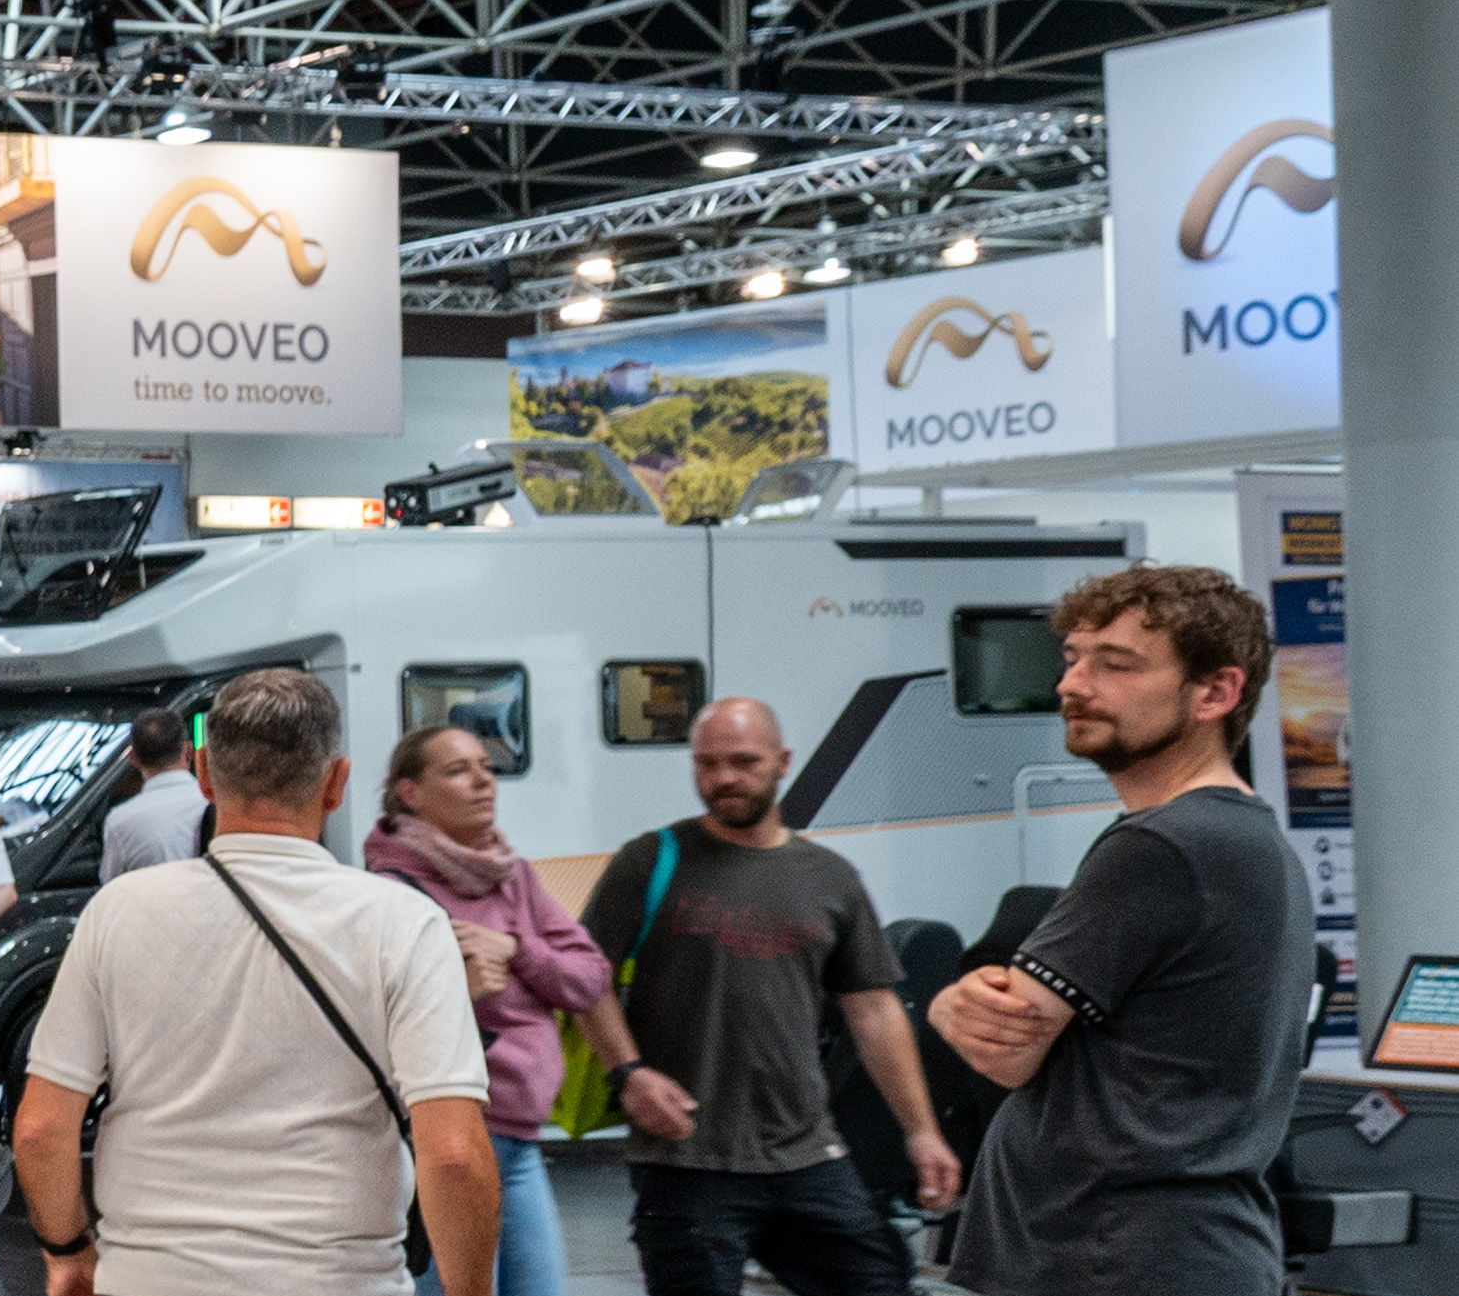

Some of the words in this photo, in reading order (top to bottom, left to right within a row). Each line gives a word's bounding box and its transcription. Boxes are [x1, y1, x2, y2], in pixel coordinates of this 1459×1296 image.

[132, 318, 331, 363] MOOVEO
[1181, 291, 1340, 356] MOO
[134, 375, 194, 403] time
[203, 378, 229, 403] to
[236, 381, 333, 406] moove.
[886, 400, 1057, 451] MOOVEO
[847, 598, 925, 618] MOOVEO
